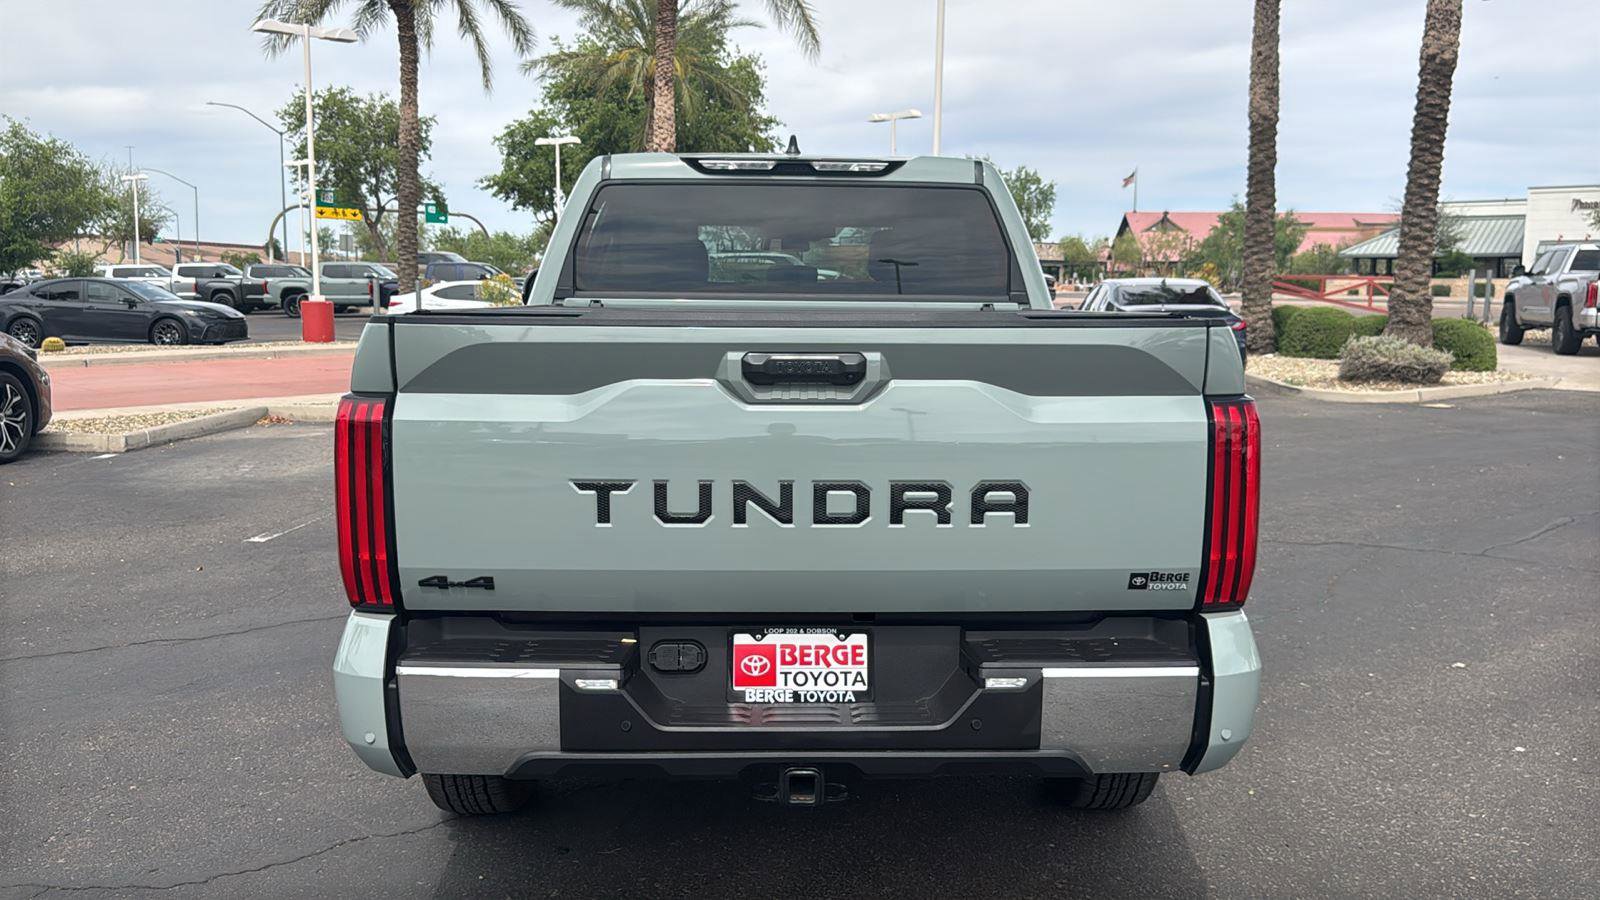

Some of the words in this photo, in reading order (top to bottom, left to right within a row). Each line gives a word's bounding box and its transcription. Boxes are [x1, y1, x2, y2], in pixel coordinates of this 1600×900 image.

[569, 478, 1032, 528] TUNDRA
[418, 575, 495, 590] 4x4
[1149, 571, 1190, 583] BERGE
[779, 644, 865, 668] BERGE
[779, 671, 867, 686] TOYOTA
[745, 689, 794, 704] BERGE
[798, 690, 856, 702] TOYOTA
